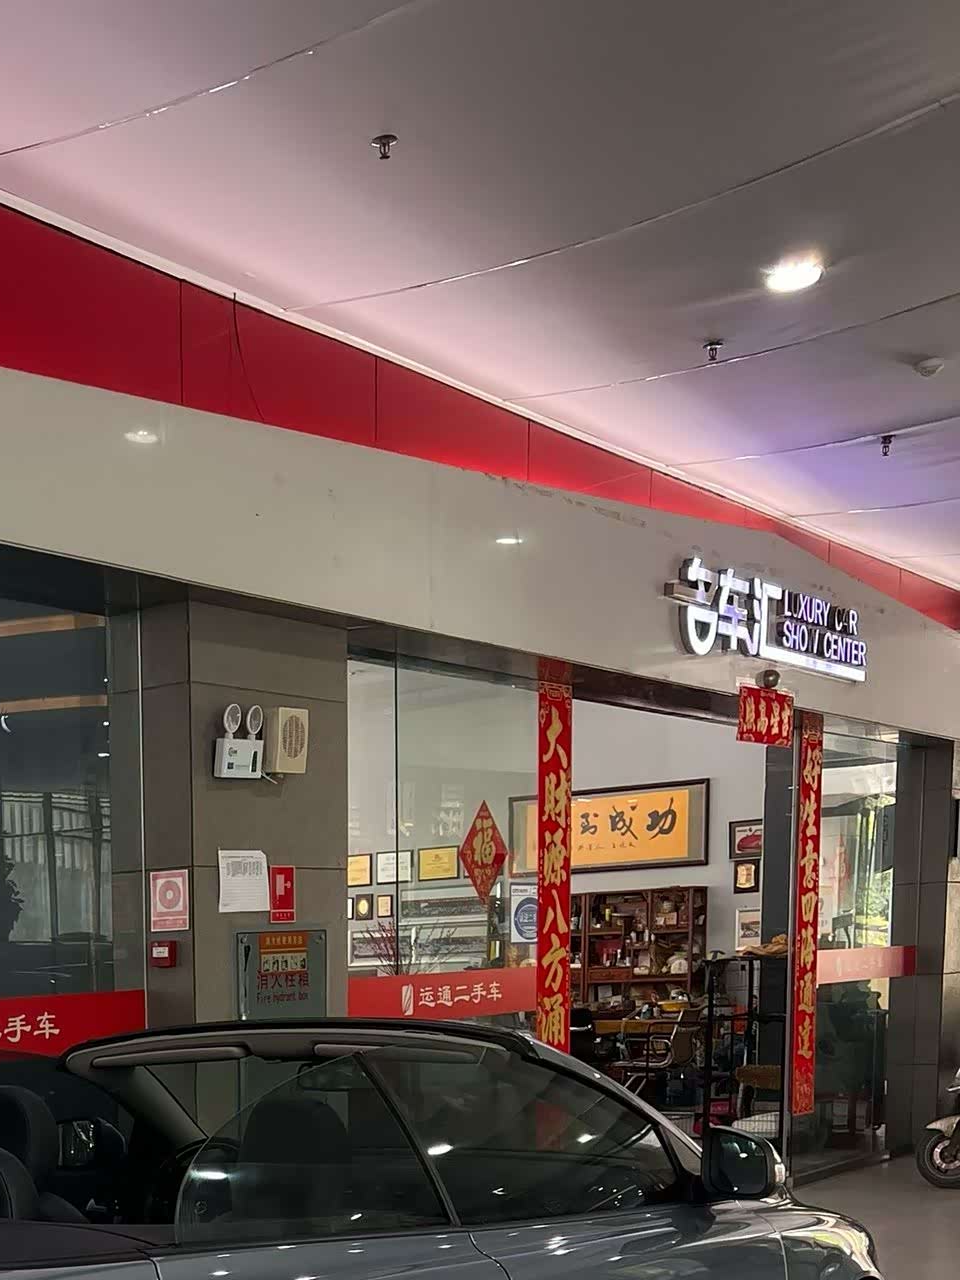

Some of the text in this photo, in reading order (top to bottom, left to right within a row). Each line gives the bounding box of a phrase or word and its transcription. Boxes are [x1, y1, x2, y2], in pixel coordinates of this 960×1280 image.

[783, 588, 831, 627] LUXURY
[823, 631, 868, 667] CENTER
[417, 983, 503, 1008] 运通二手车
